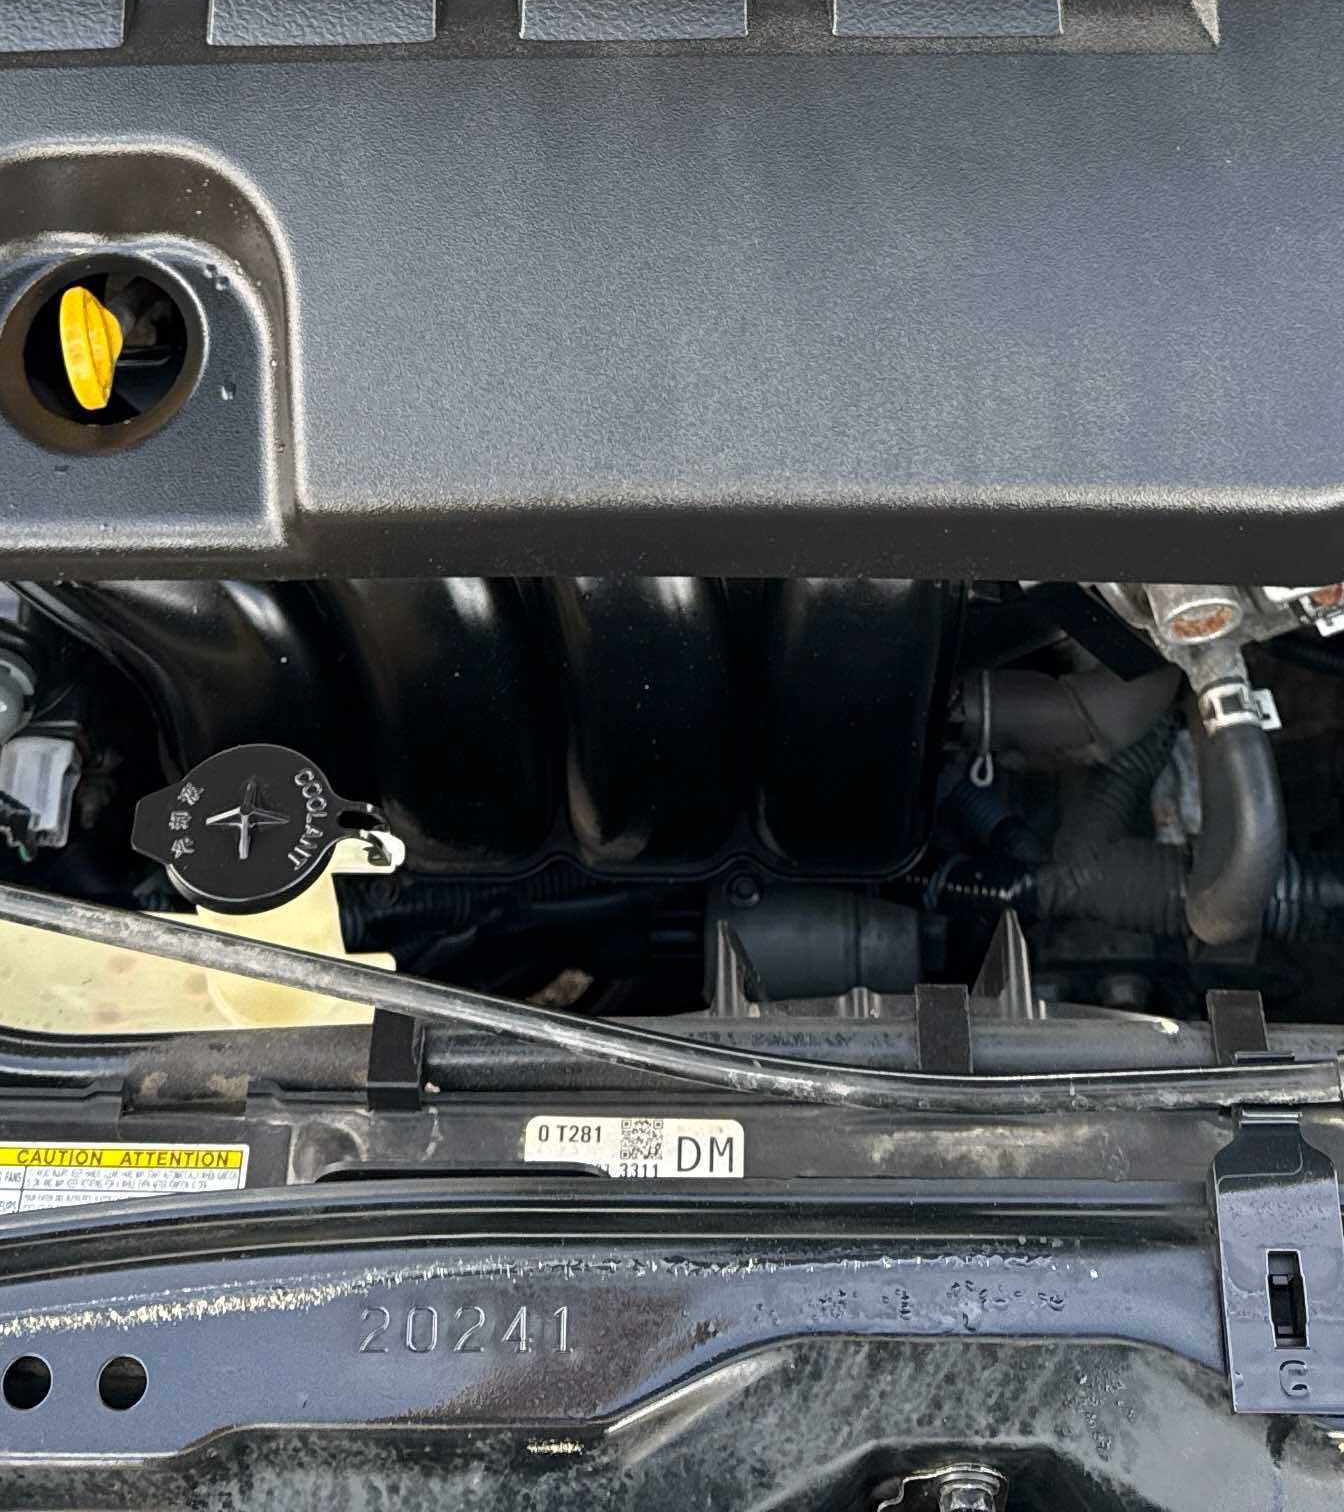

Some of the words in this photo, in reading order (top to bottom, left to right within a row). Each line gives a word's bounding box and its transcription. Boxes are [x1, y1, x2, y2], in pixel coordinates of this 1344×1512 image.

[287, 767, 329, 872] COOLANT
[556, 1125, 601, 1143] T281
[17, 1149, 103, 1164] CAUTION
[120, 1150, 229, 1167] ATTENTION
[677, 1135, 733, 1173] DM
[4, 1171, 22, 1183] FANS
[359, 1305, 574, 1353] 20241
